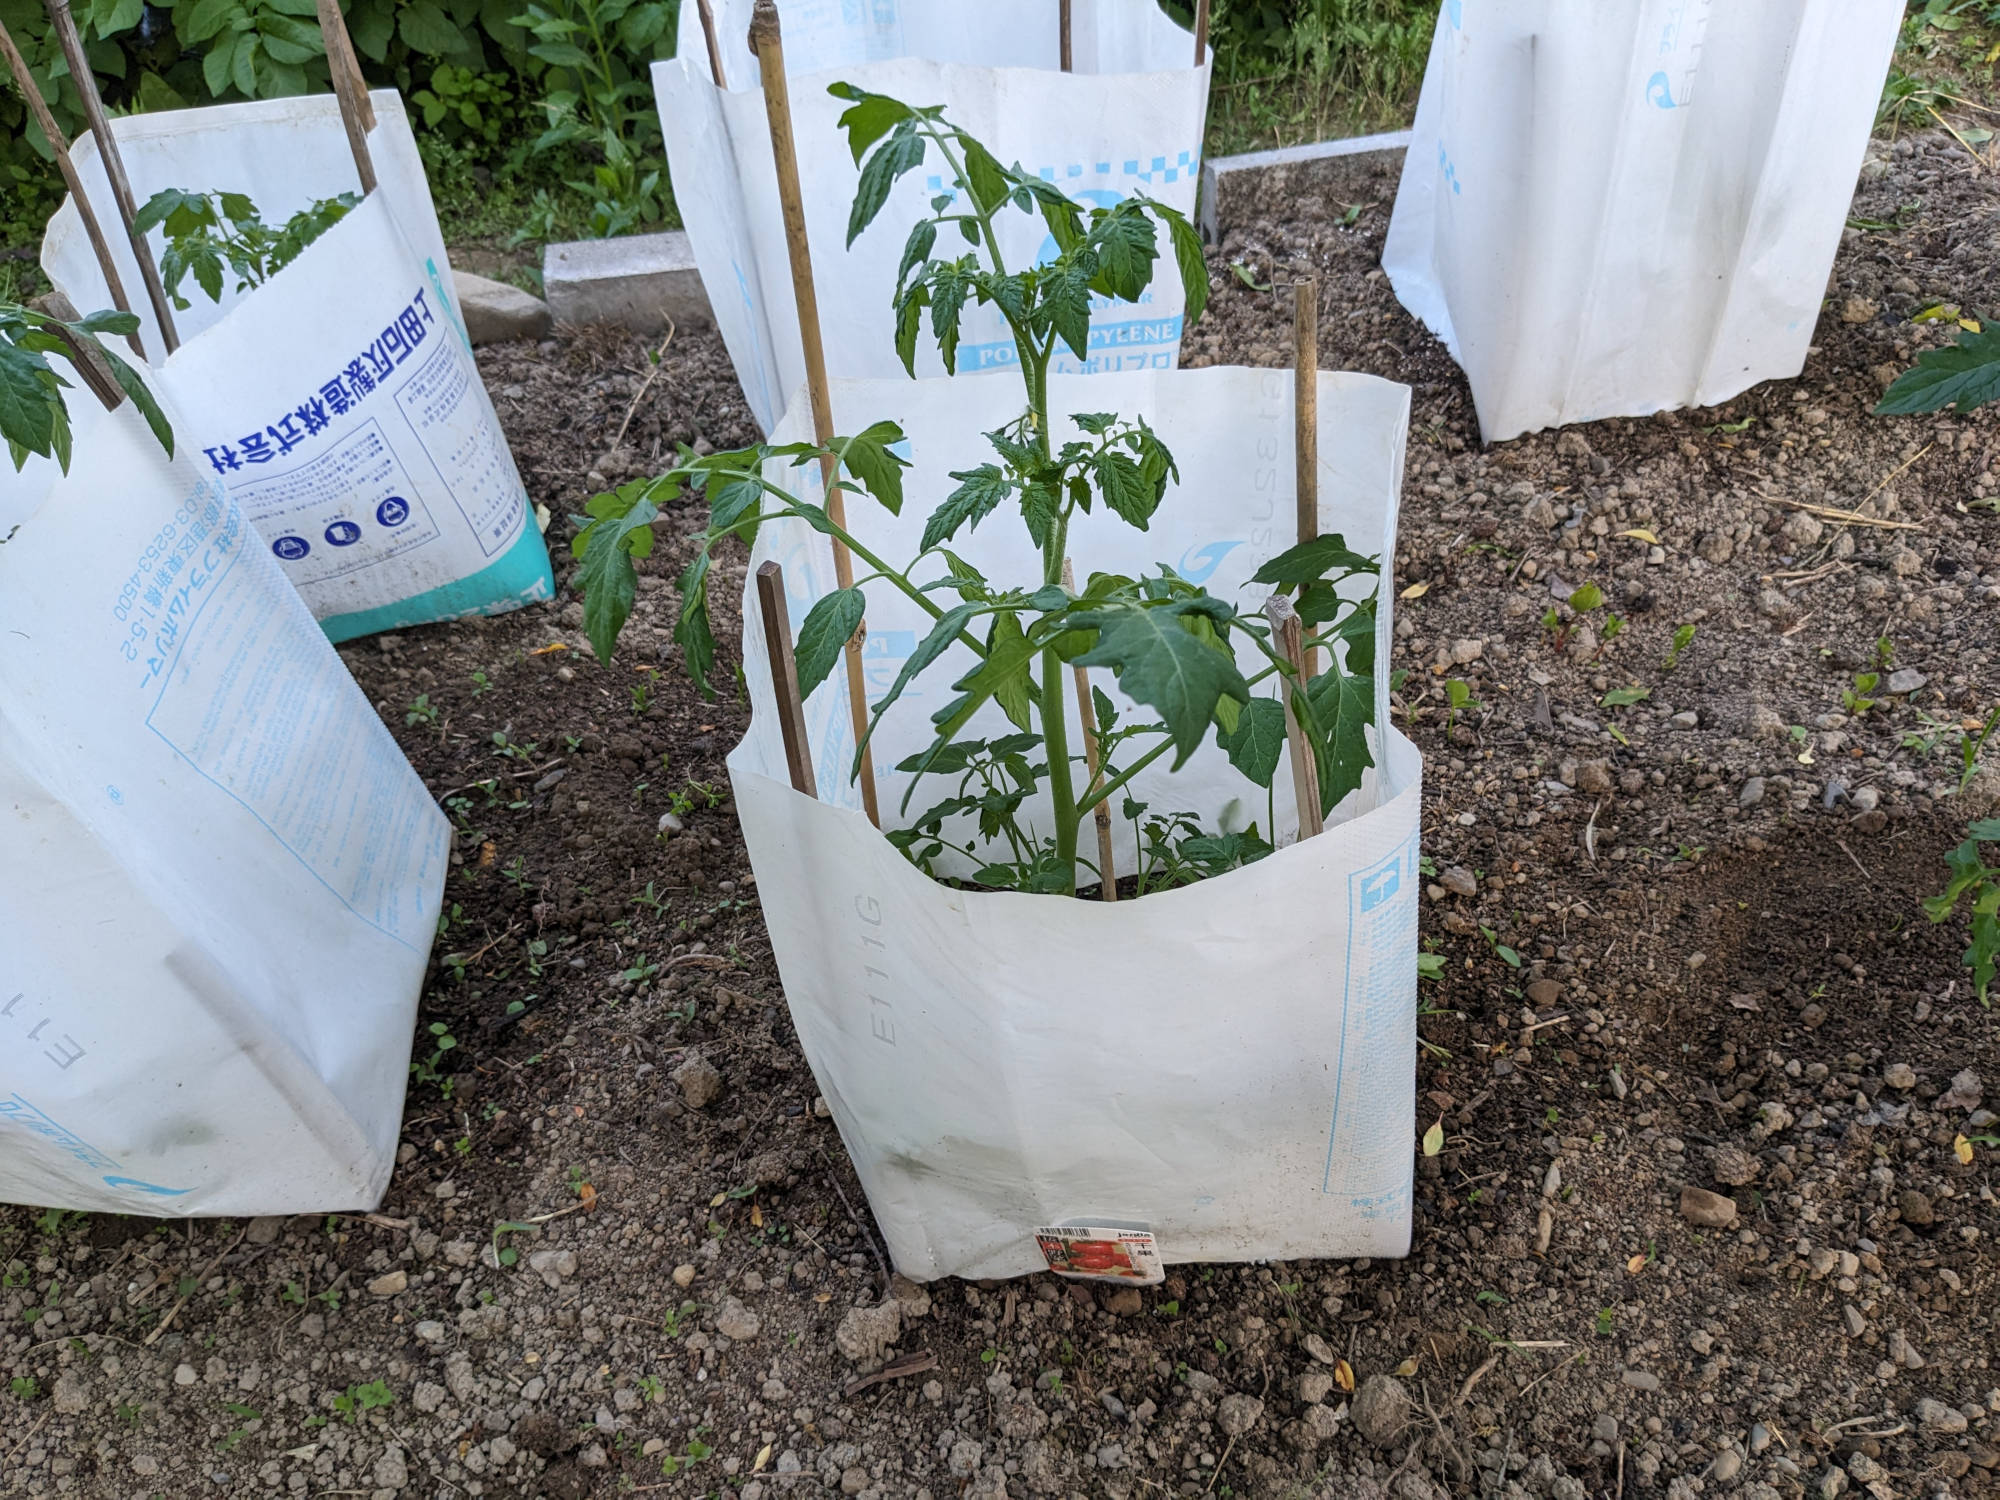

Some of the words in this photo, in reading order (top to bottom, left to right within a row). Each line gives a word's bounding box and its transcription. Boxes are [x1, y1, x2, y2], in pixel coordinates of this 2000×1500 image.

[204, 287, 434, 474] 上田石灰製造株式会社
[854, 895, 897, 1047] E111G
